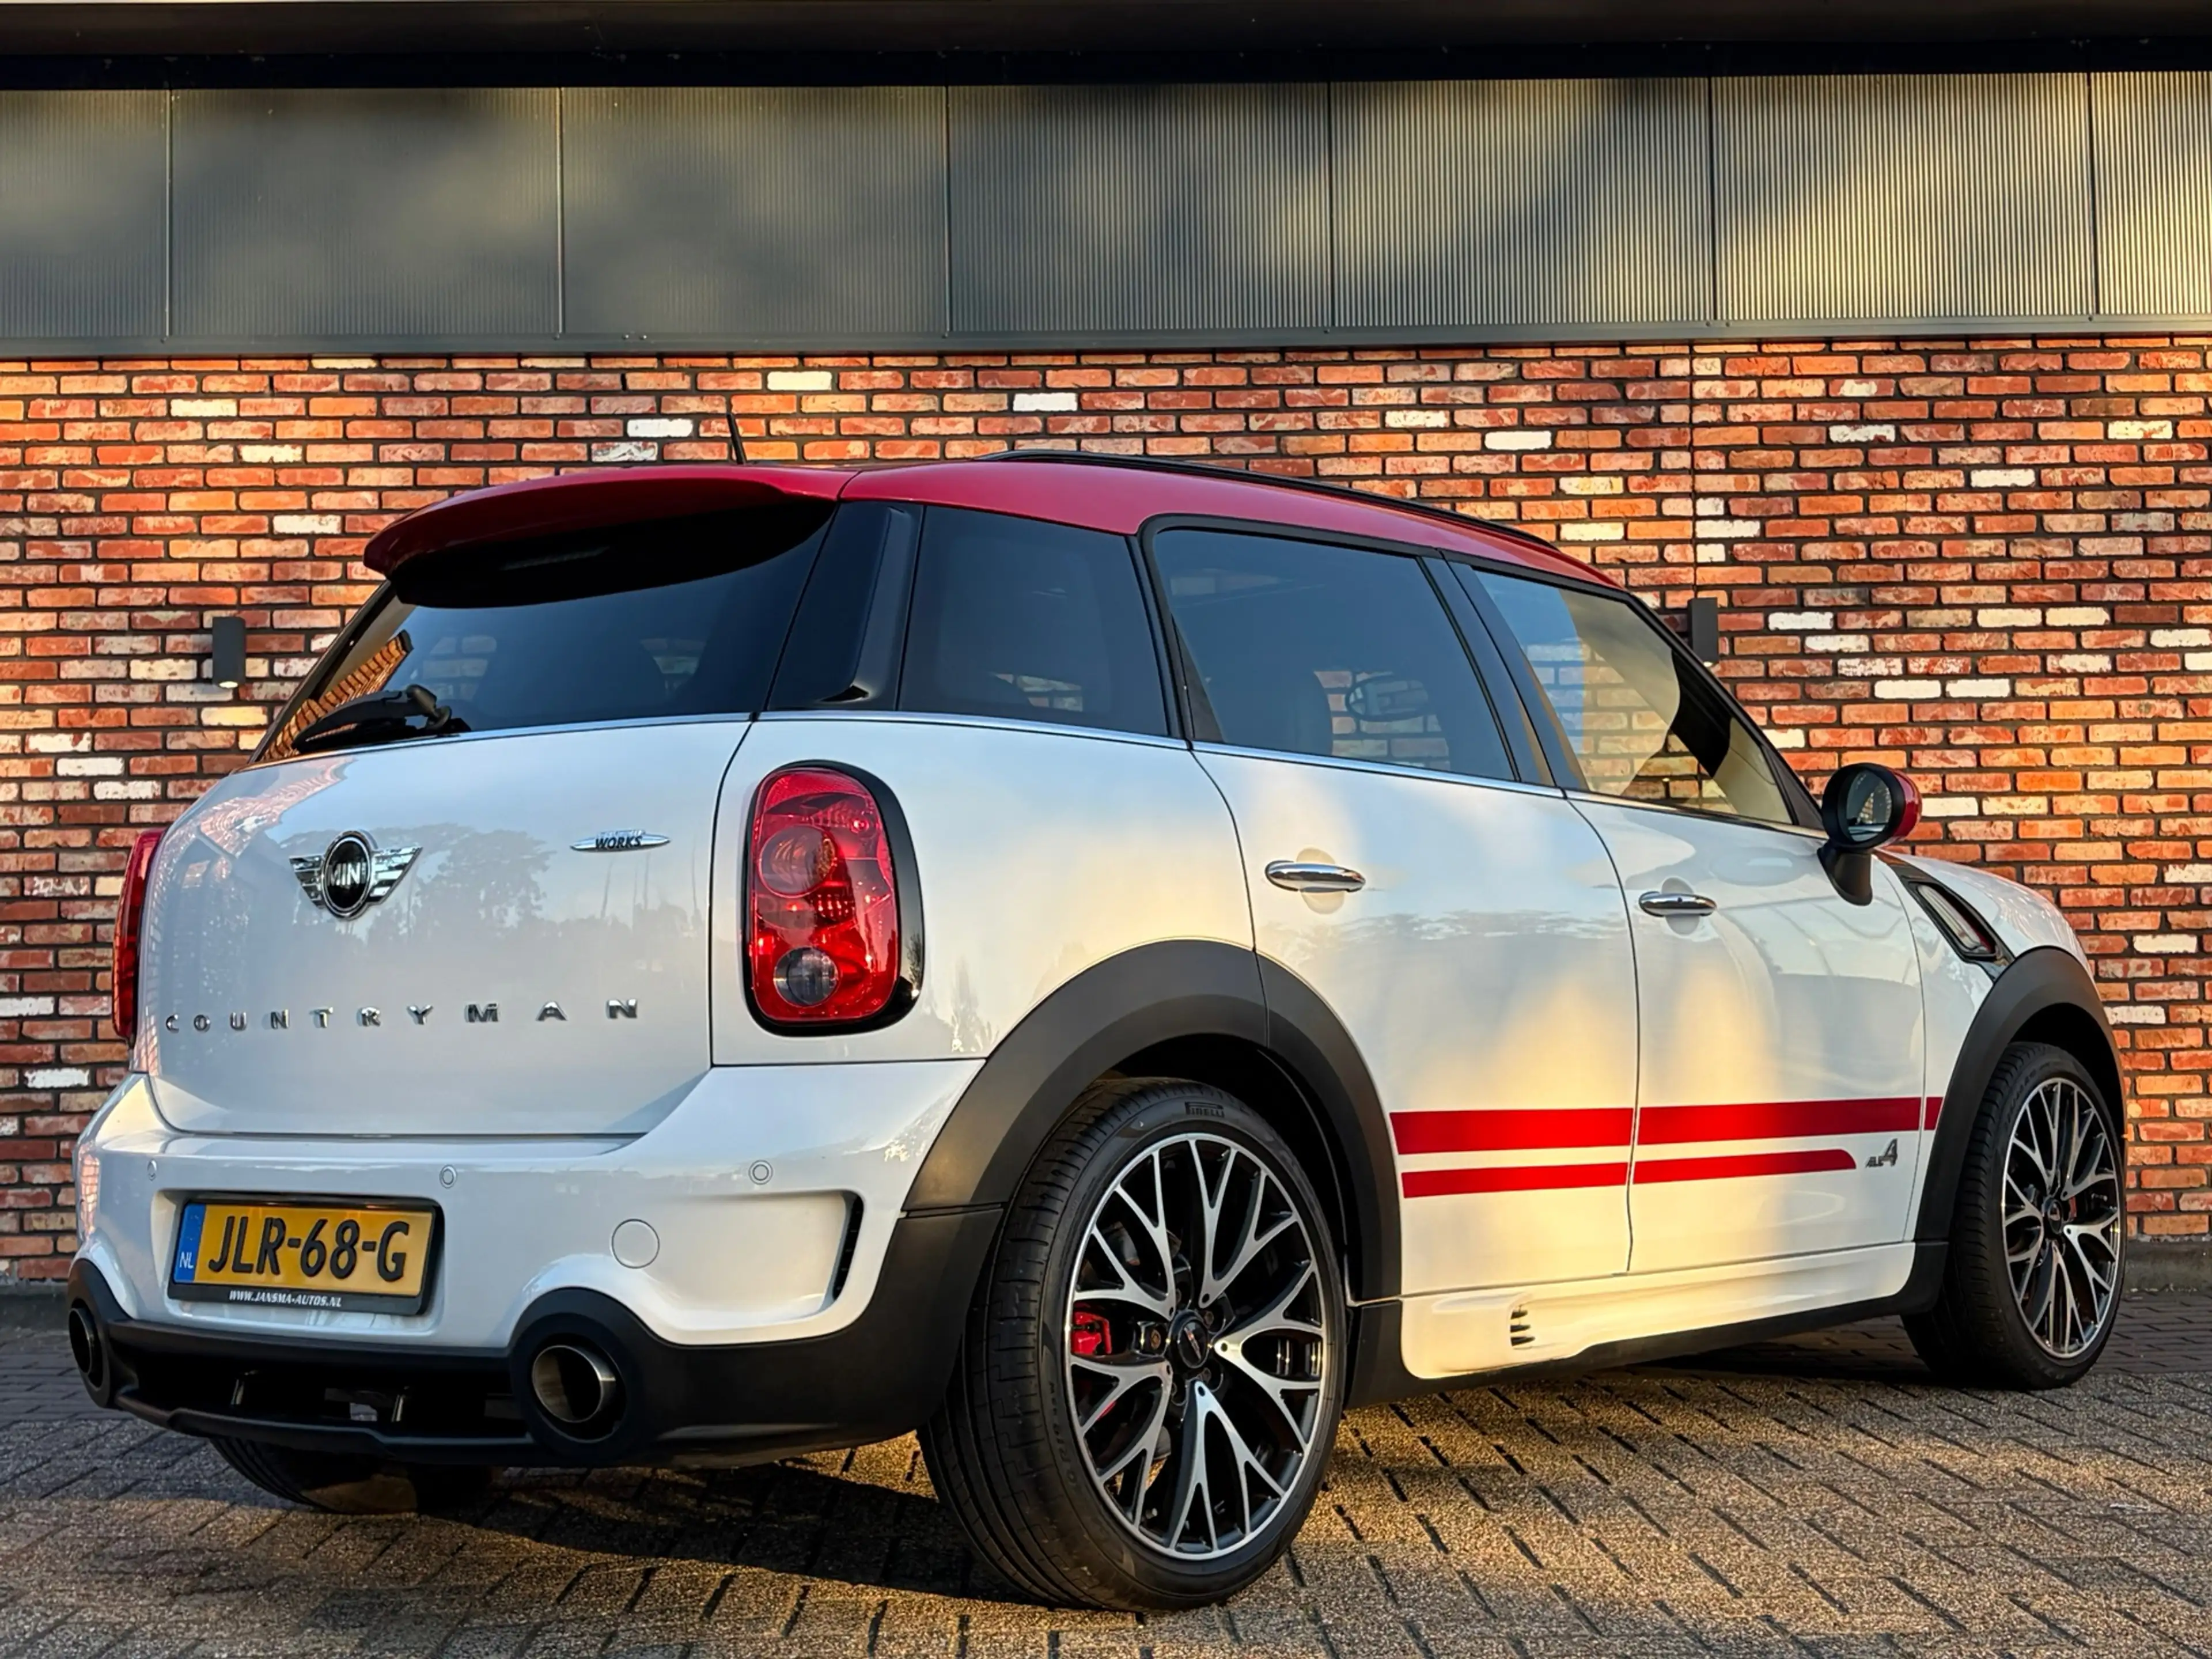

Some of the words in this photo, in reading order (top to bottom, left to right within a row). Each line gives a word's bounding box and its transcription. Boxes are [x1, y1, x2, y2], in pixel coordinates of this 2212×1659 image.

[595, 835, 643, 850] WORKS
[328, 861, 367, 888] MINI
[165, 999, 638, 1033] COUNTRYMAN
[1184, 1101, 1225, 1119] PIRELLI
[209, 1216, 410, 1282] JLR-68-G
[179, 1251, 194, 1270] NL
[229, 1290, 342, 1308] WWW.JANSMA-AUTOS.NL
